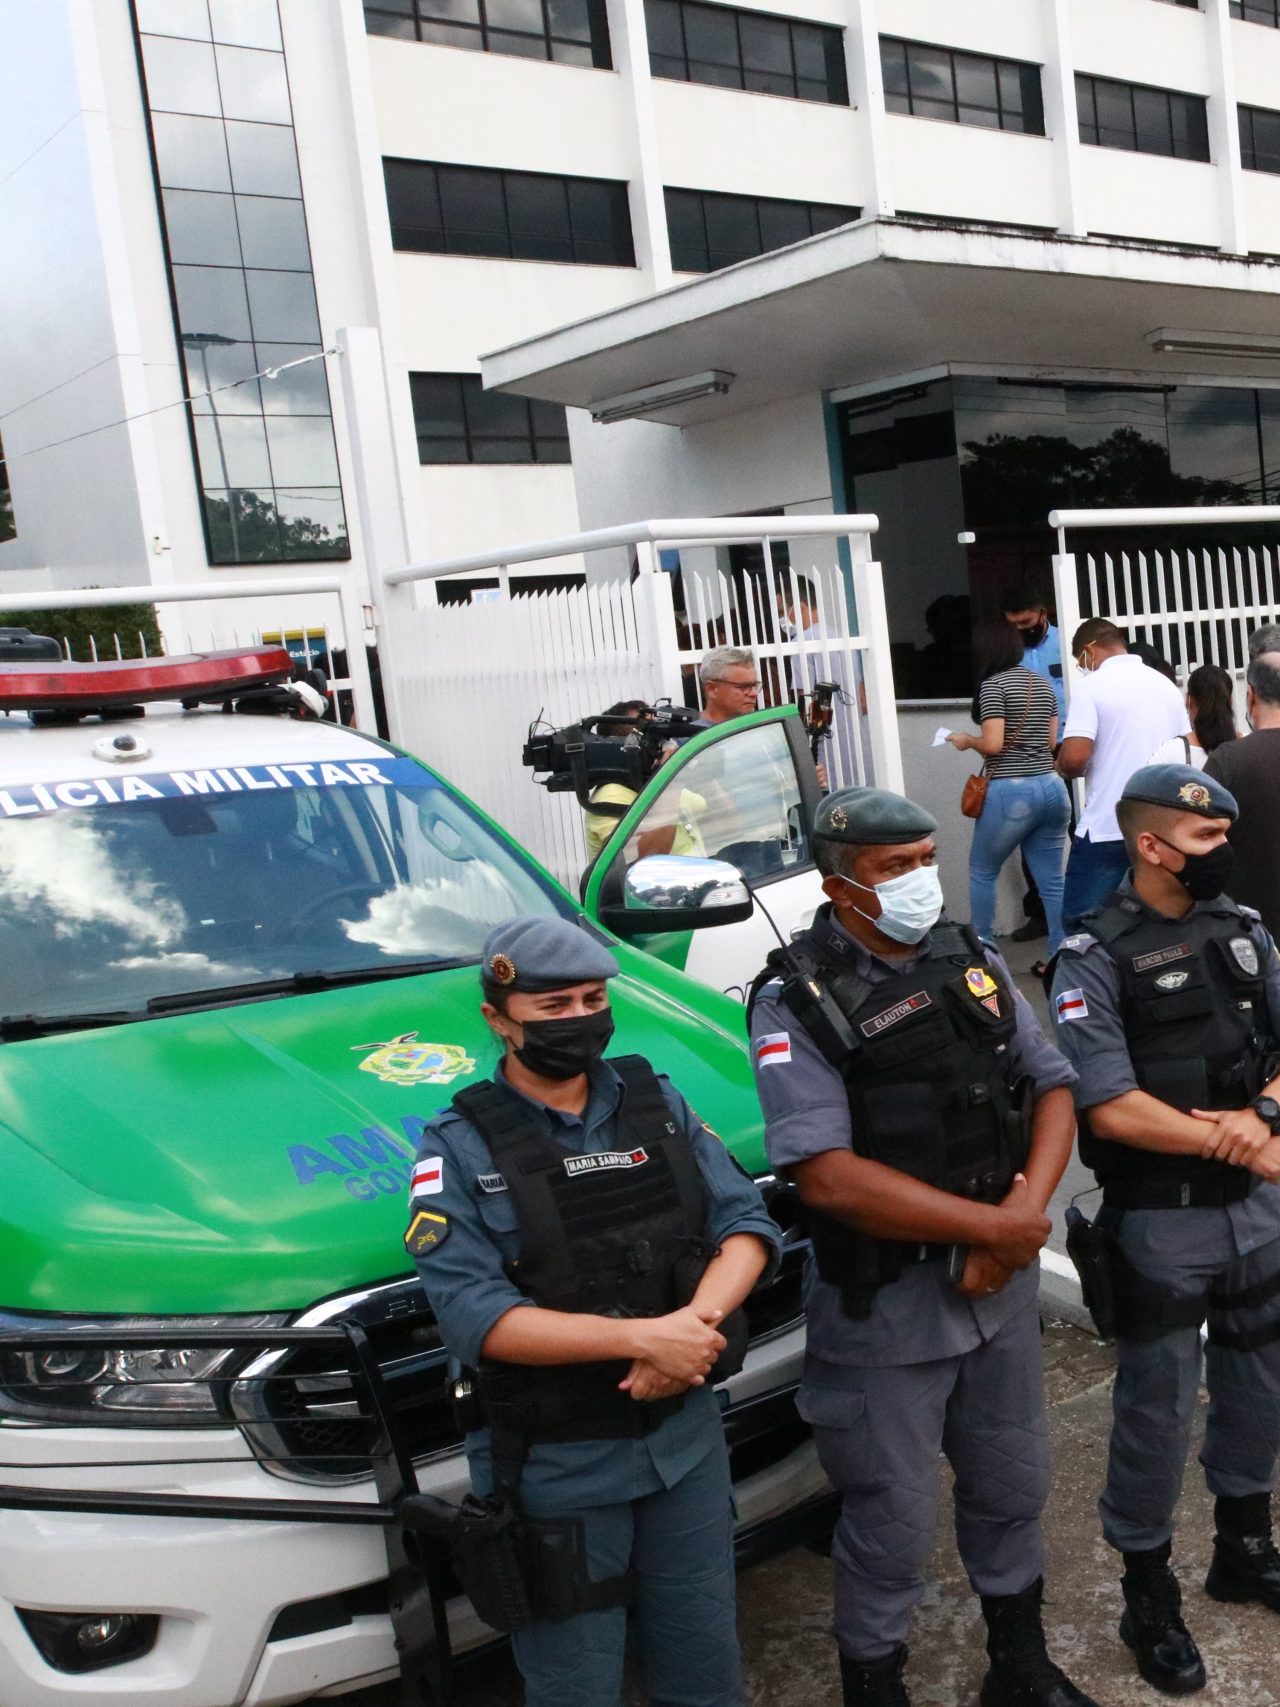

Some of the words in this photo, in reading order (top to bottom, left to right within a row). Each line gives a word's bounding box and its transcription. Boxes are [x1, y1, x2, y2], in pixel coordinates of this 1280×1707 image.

[289, 648, 320, 658] Estcio
[168, 762, 393, 795] MILITAR
[1137, 954, 1163, 968] MARCOS
[1164, 947, 1183, 960] PAULO
[568, 1157, 597, 1172] MARIA
[598, 1155, 633, 1167] SAMPAIO
